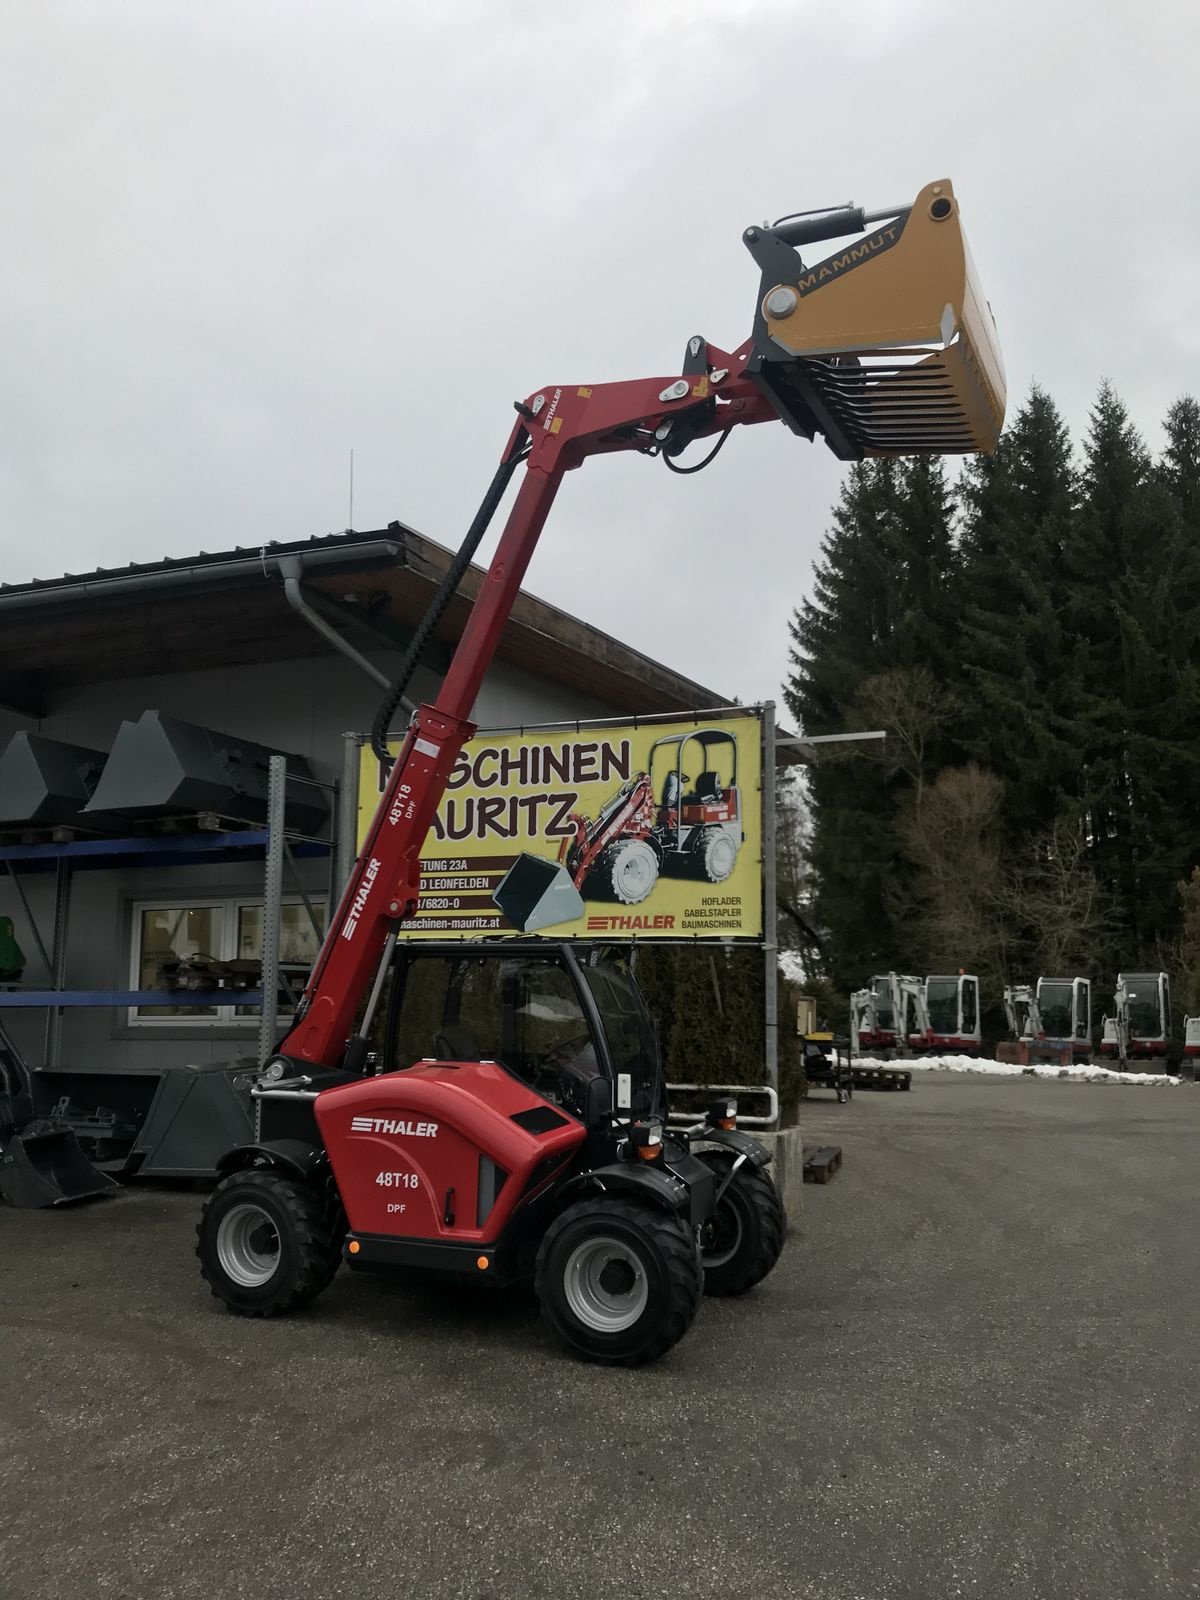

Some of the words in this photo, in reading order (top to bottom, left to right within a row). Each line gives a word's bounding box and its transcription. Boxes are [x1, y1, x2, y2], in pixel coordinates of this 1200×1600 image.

[798, 227, 896, 290] MAMMUT
[388, 784, 412, 826] 48T18
[405, 800, 417, 819] DPF
[449, 860, 468, 870] 23A
[429, 877, 489, 889] LEONFELDEN
[702, 897, 742, 905] HOFLADER
[684, 908, 742, 917] GABELSTAPLER
[681, 920, 742, 929] BAUMASCHINEN
[376, 1172, 419, 1189] 48T18
[387, 1203, 406, 1214] DPF
